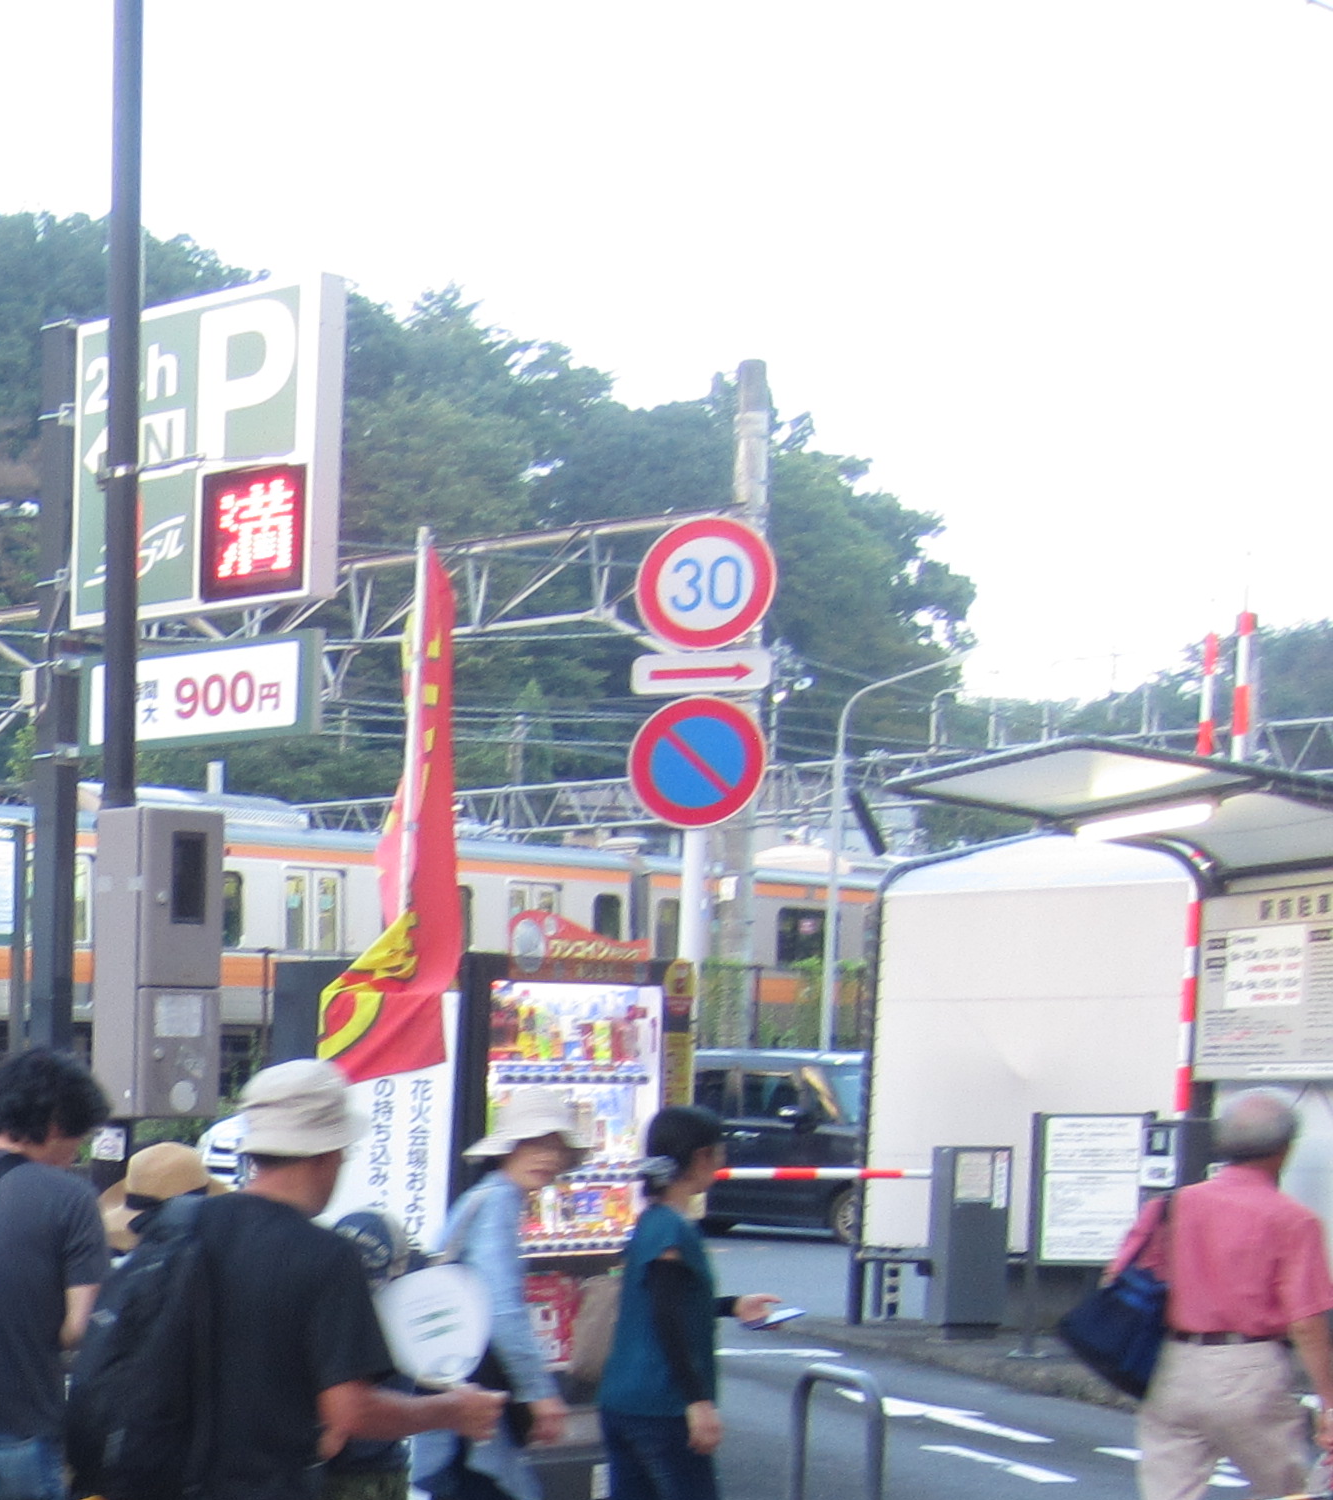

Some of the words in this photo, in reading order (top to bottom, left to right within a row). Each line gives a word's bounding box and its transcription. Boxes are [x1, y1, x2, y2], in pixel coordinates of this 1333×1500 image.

[84, 343, 179, 415] 2h
[197, 299, 296, 466] P
[217, 479, 294, 578] 満
[671, 556, 742, 612] 30
[175, 671, 281, 720] 900円
[367, 1078, 396, 1209] の持ち込み、
